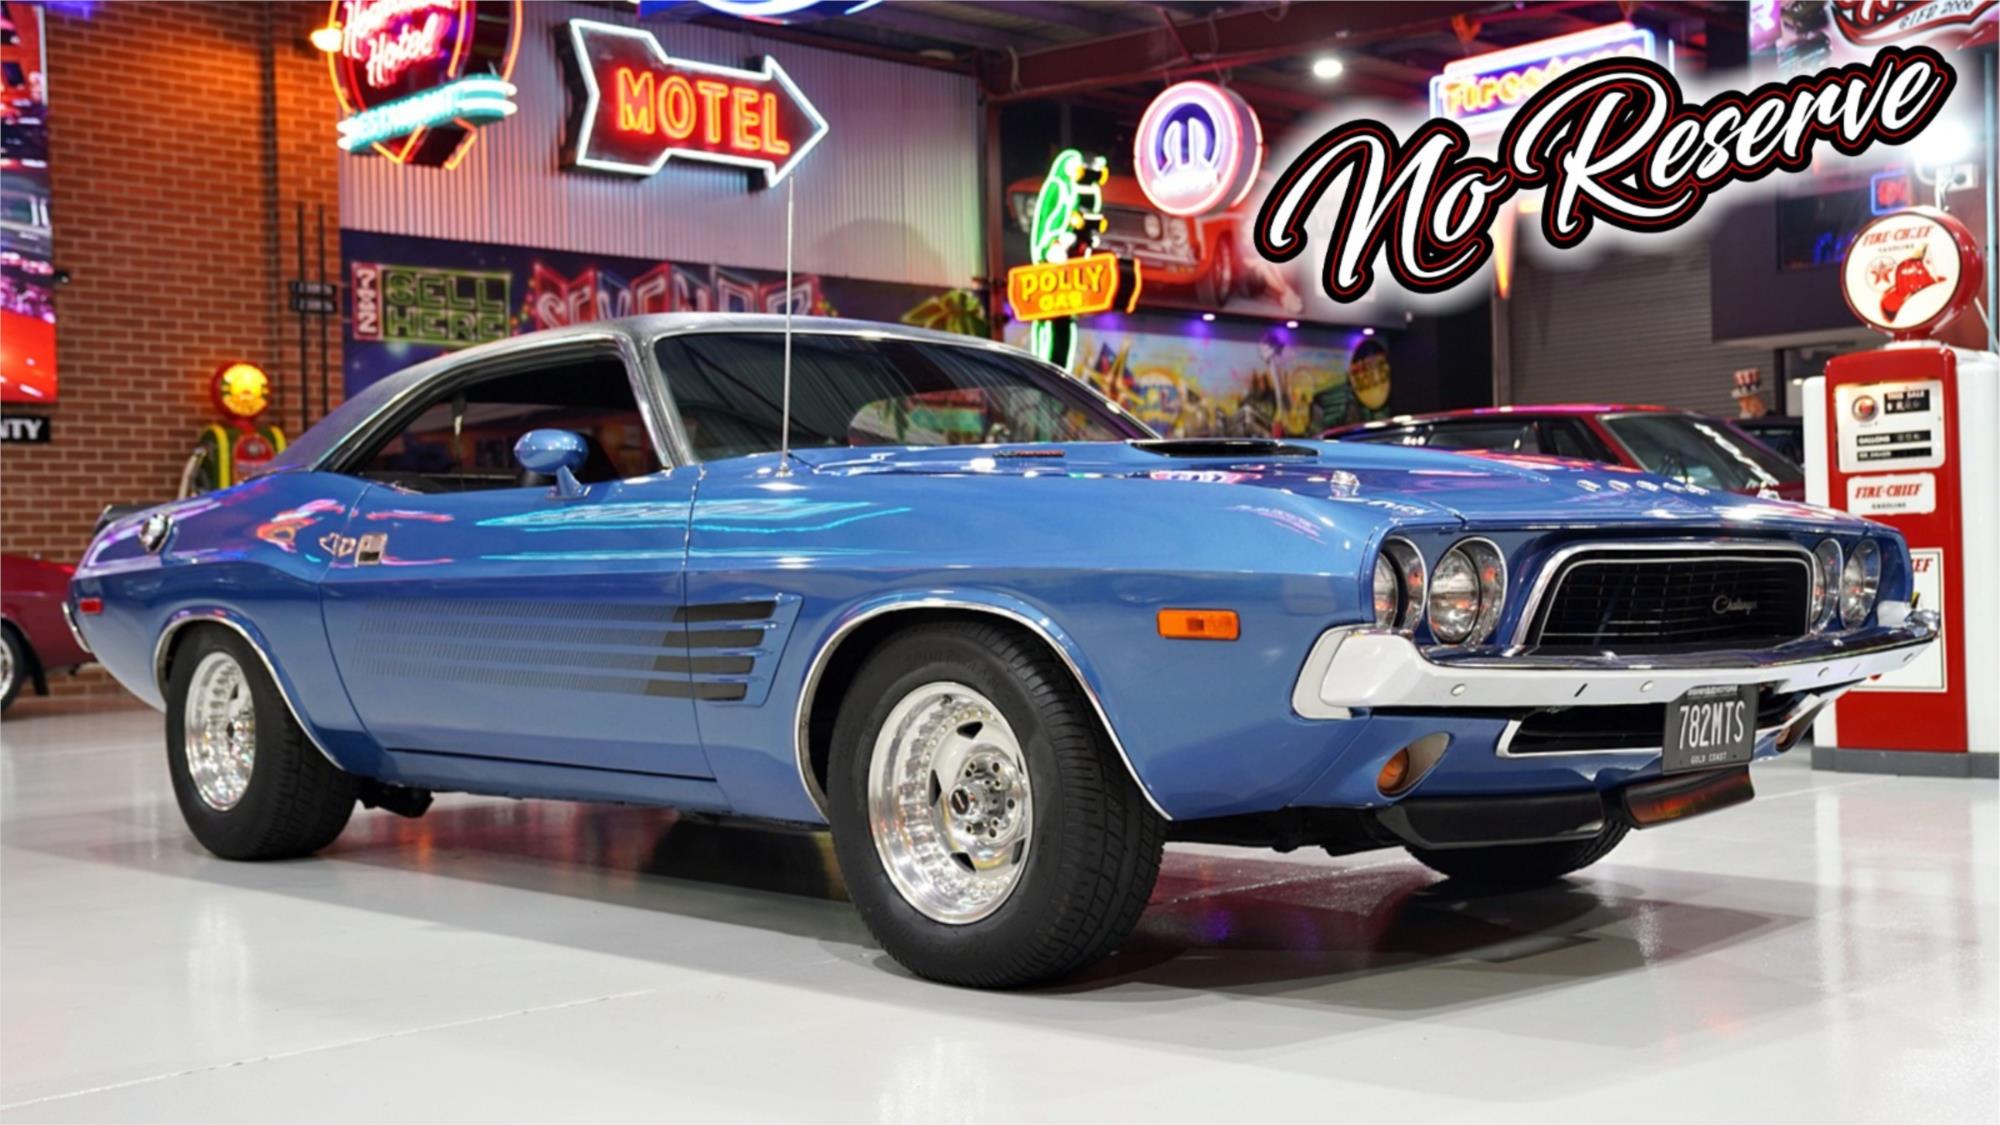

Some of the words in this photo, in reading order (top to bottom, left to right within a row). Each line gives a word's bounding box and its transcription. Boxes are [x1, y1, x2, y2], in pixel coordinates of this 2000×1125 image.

[366, 13, 440, 86] Hotel
[615, 66, 790, 155] MOTEL
[386, 272, 506, 309] SELL
[1021, 264, 1103, 301] POLLY
[386, 304, 506, 342] HERE
[1855, 483, 1922, 499] FIRE-CHIEF
[1679, 700, 1746, 750] 782MTS
[1708, 752, 1728, 762] COAST
